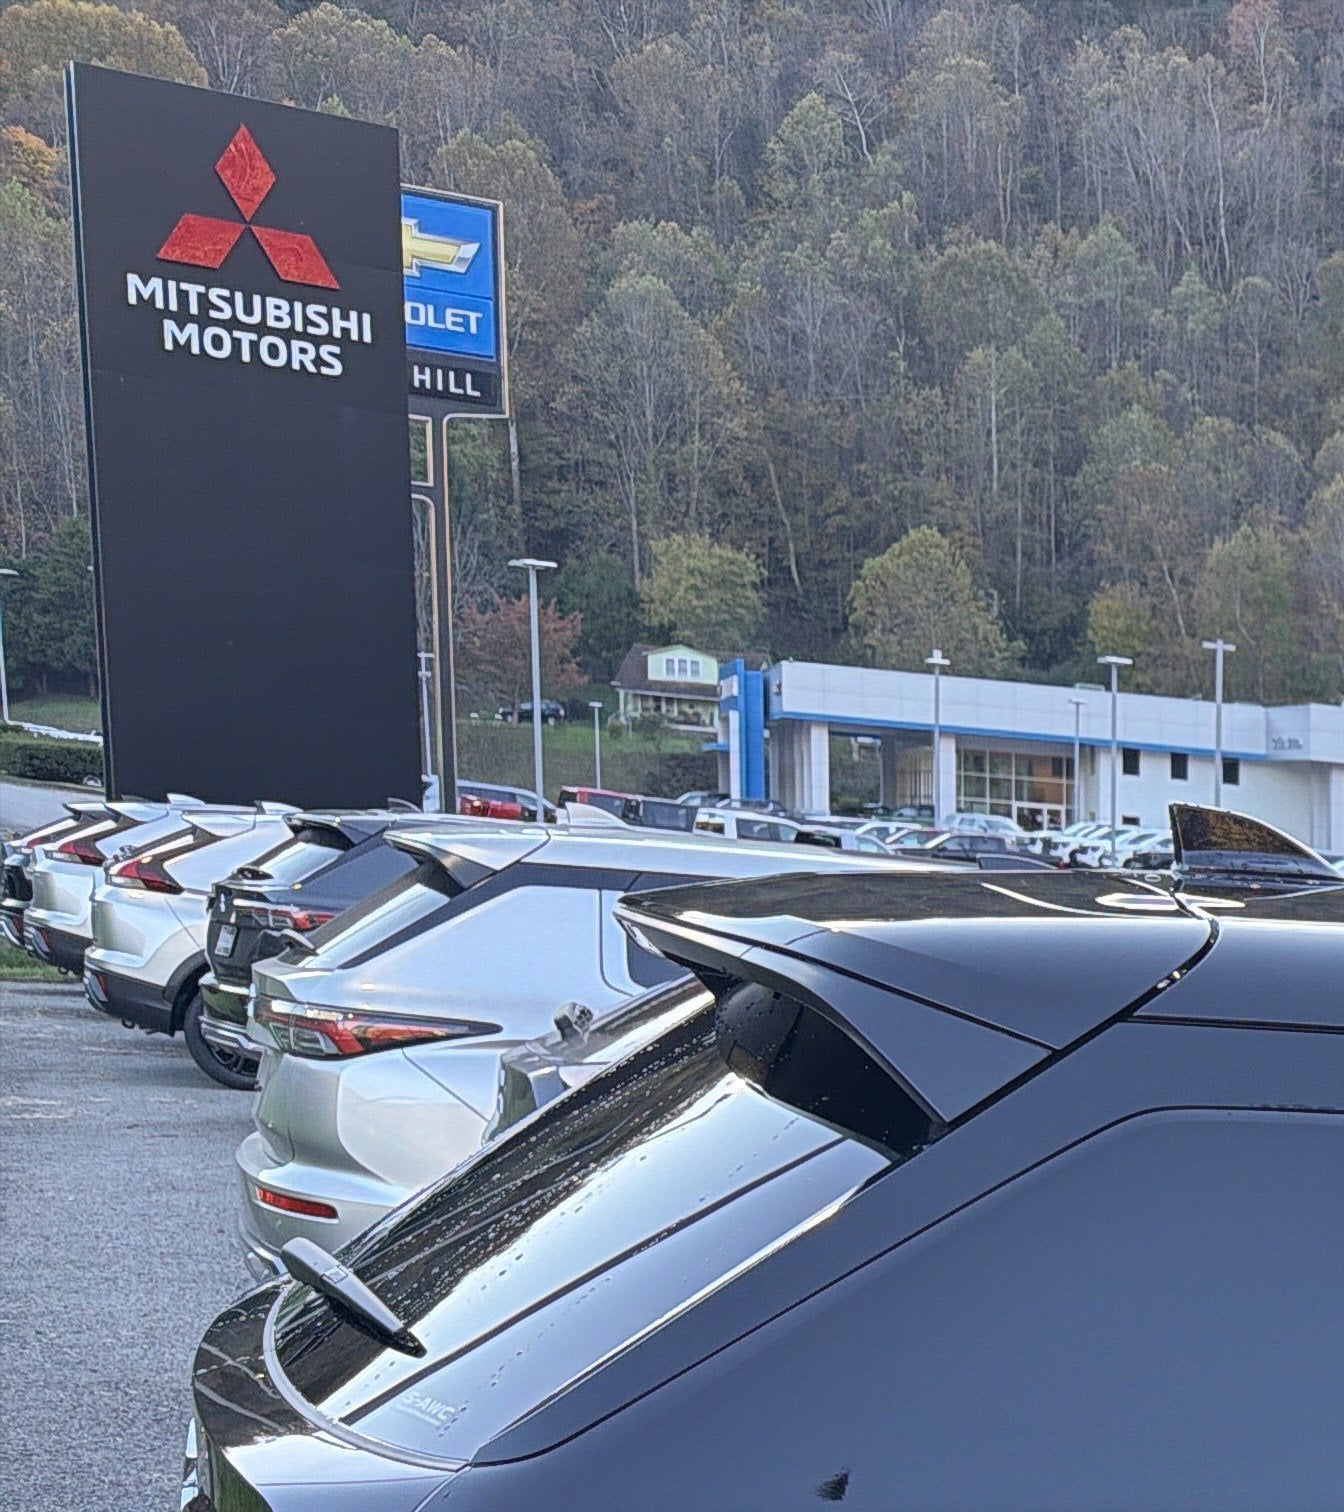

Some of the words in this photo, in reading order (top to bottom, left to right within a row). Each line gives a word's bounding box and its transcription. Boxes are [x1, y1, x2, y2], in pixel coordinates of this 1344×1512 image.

[126, 272, 372, 343] MITSUBISHI
[163, 318, 343, 376] MOTORS
[413, 364, 481, 397] HILL
